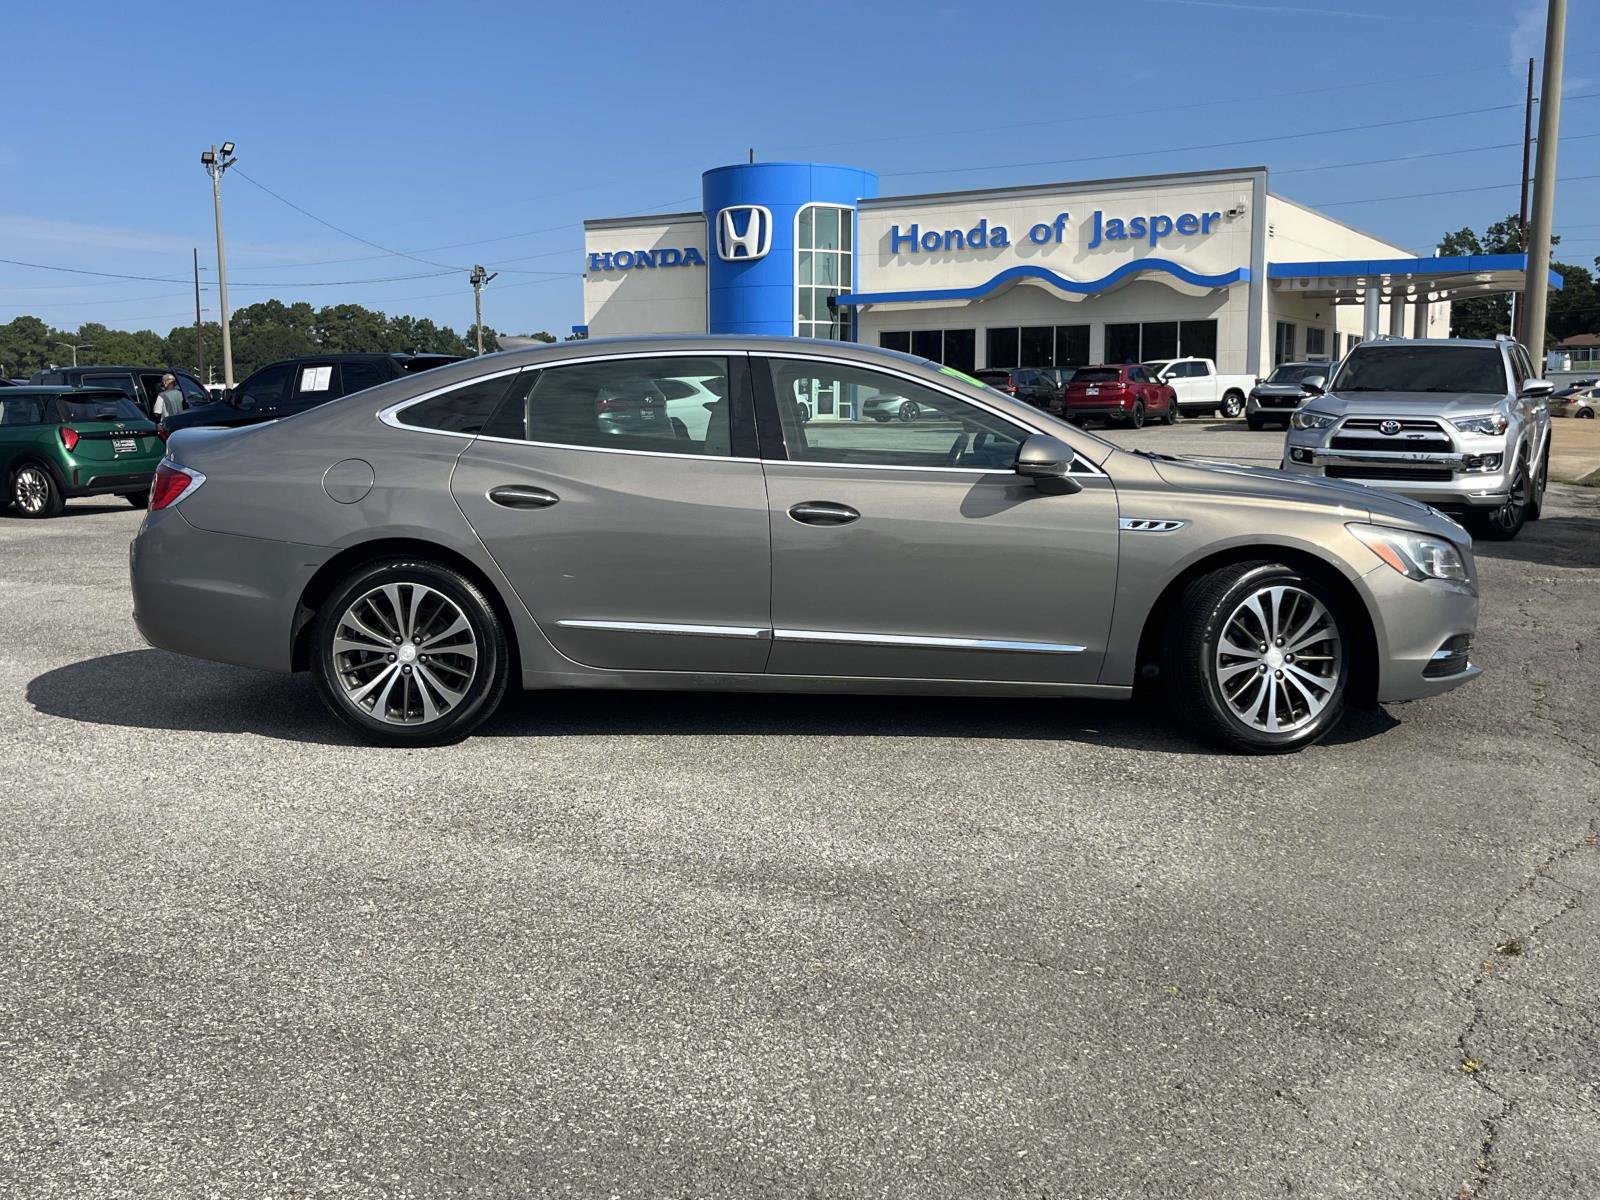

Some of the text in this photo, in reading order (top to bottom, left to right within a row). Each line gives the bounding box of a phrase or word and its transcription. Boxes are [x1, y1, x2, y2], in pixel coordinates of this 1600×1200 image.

[892, 210, 1221, 254] Honda of Jasper
[588, 247, 705, 271] HONDA
